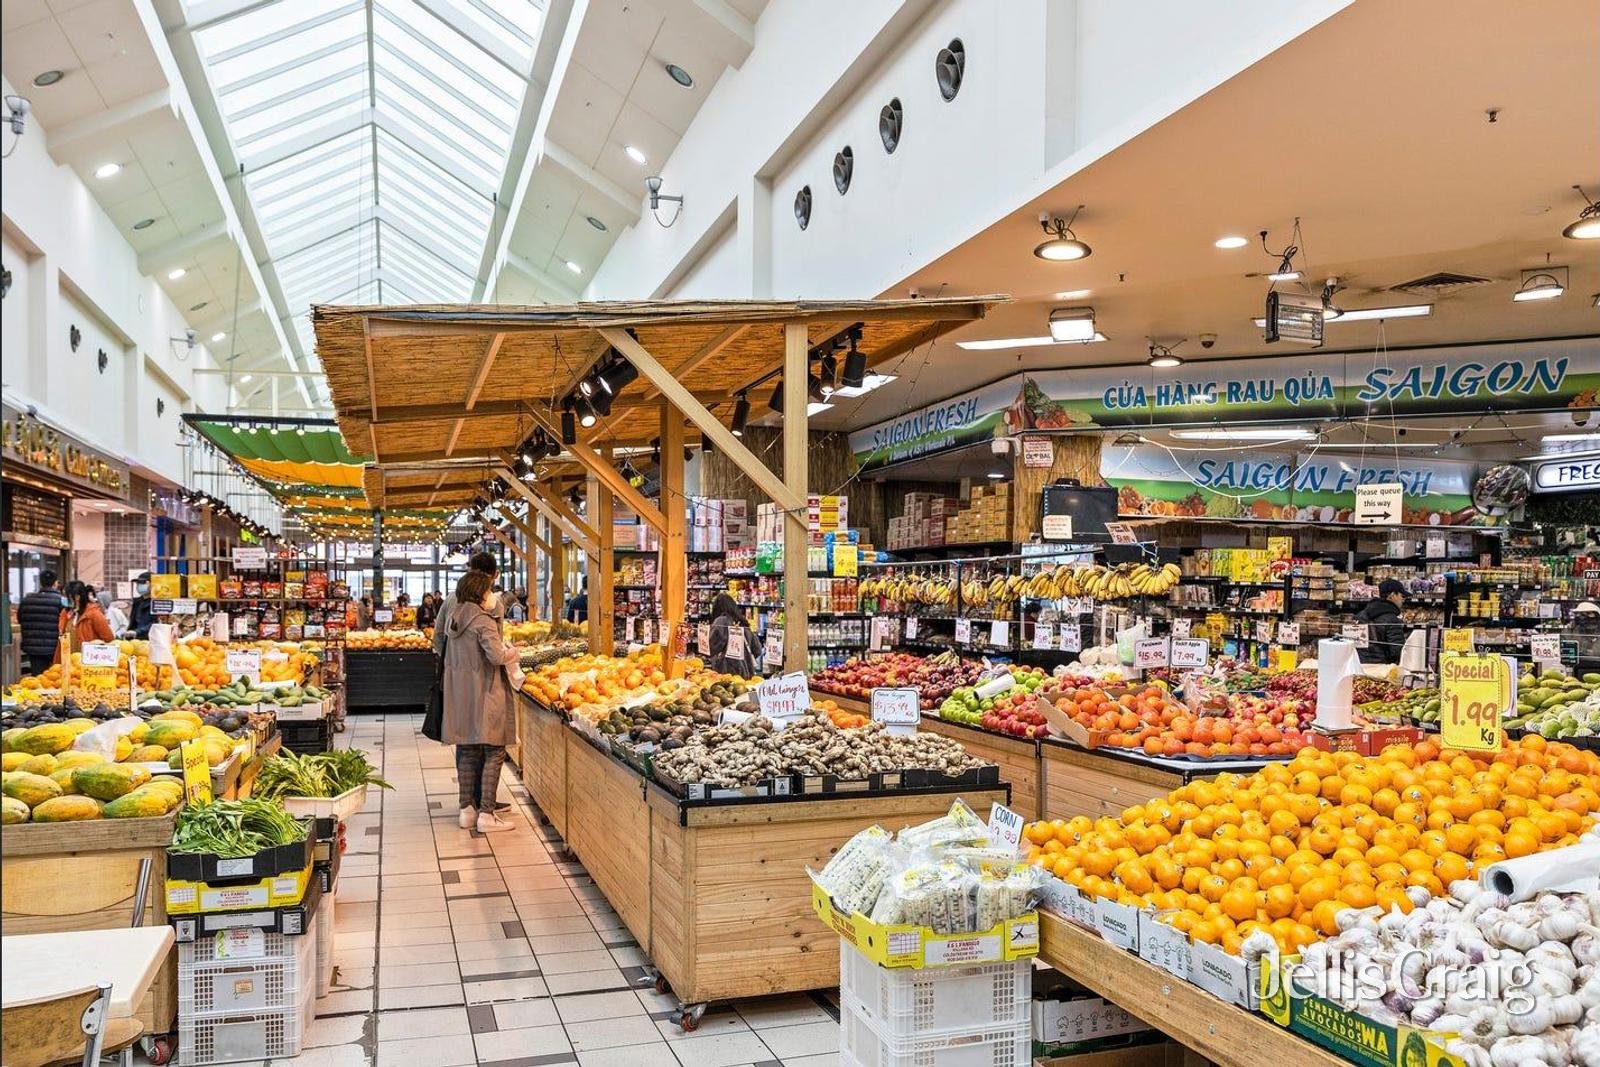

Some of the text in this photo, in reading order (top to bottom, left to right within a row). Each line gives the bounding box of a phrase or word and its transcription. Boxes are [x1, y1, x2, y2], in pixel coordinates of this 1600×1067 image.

[1103, 380, 1148, 408] CỬA
[1155, 381, 1218, 406] HÀNG
[1227, 379, 1275, 403] RAU
[1358, 357, 1569, 401] SAIGON
[872, 416, 922, 451] SAIGON
[925, 396, 979, 433] FRESH
[1195, 458, 1434, 496] SAIGON FRESH
[1357, 488, 1401, 497] Please queue
[1364, 499, 1391, 508] this way
[1444, 660, 1494, 683] Special
[1444, 688, 1498, 728] $1.99
[1481, 728, 1495, 745] Kg
[995, 806, 1018, 829] CORN
[1302, 1006, 1362, 1043] AVOCADOS
[1303, 998, 1361, 1030] PEMBERTON
[1361, 1023, 1388, 1056] WA
